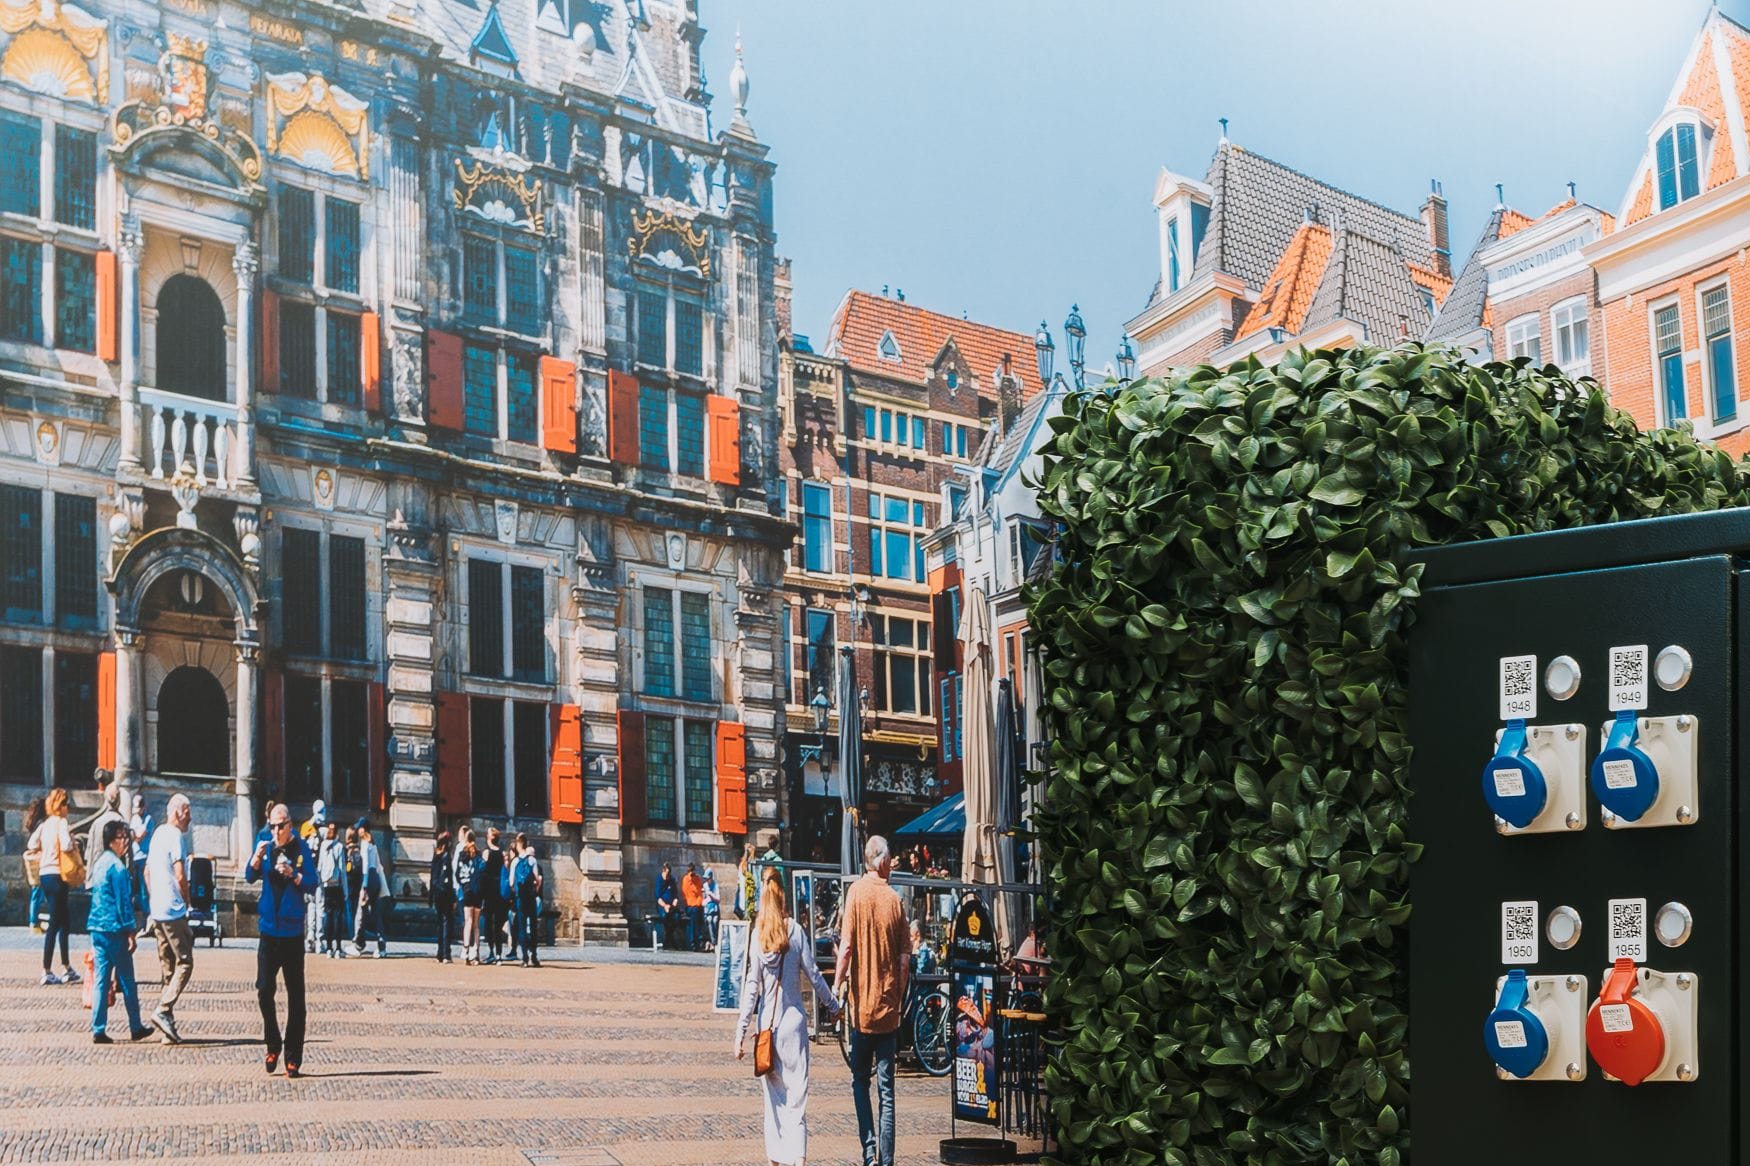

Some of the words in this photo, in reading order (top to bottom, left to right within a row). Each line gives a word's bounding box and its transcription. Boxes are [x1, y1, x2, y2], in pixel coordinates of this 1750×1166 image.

[1616, 691, 1641, 704] 1949
[1507, 700, 1531, 713] 1948
[1507, 945, 1533, 957] 1950
[1615, 944, 1641, 956] 1955
[956, 1061, 977, 1082] BEER
